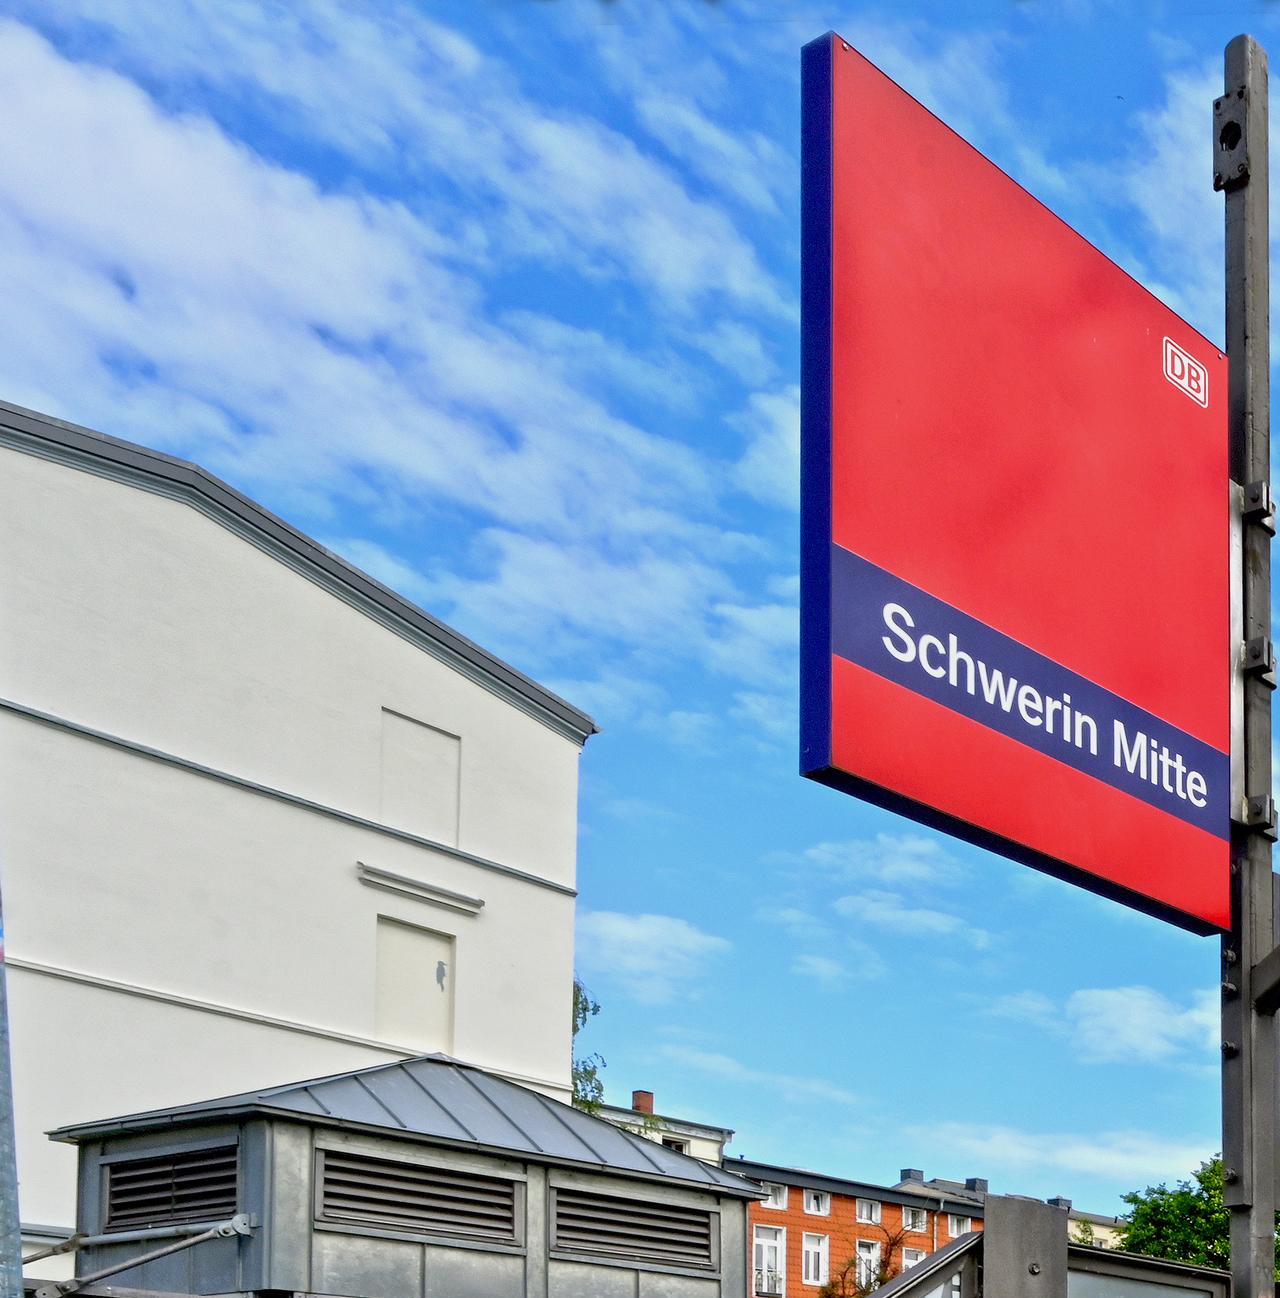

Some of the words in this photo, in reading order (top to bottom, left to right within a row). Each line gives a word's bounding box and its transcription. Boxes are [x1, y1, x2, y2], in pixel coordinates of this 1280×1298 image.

[1168, 344, 1204, 398] DB
[882, 602, 1098, 756] Schwerin
[1113, 719, 1208, 808] Mitte
